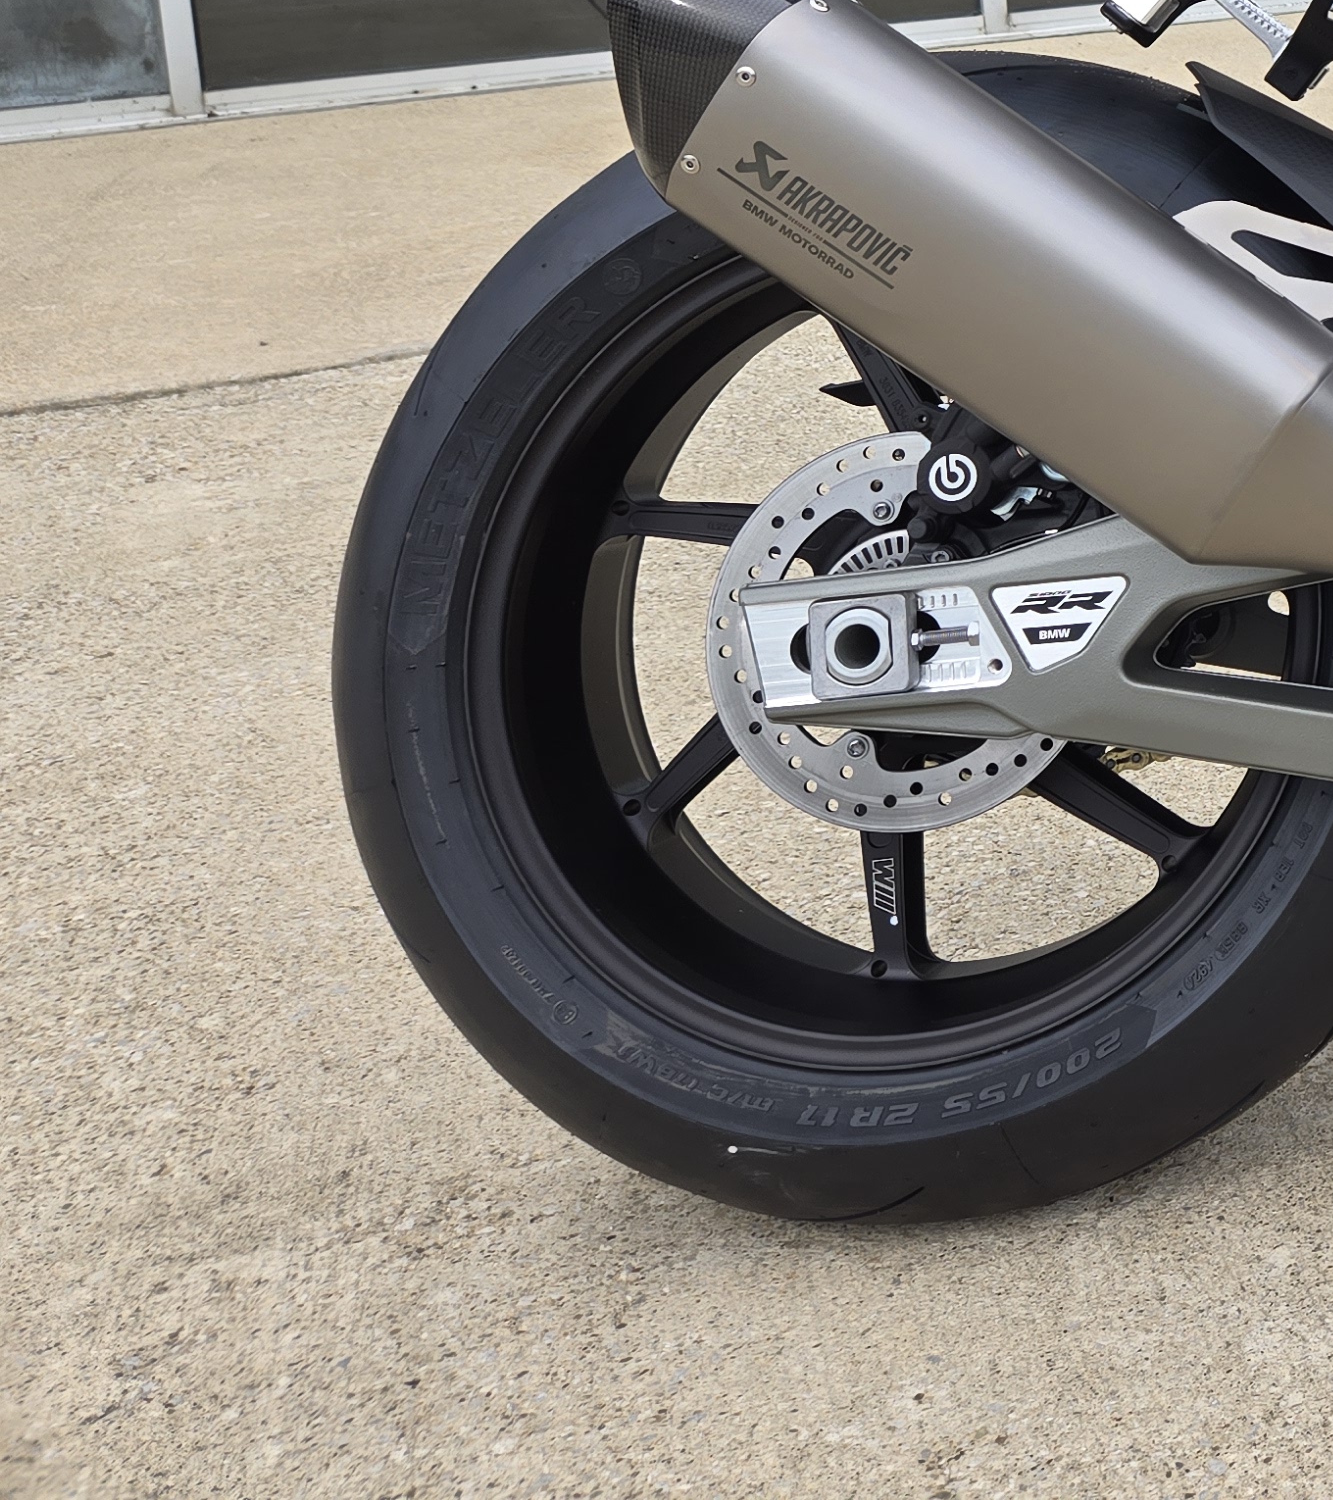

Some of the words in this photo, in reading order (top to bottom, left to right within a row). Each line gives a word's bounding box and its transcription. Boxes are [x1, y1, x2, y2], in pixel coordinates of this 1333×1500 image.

[742, 199, 779, 227] BMW
[778, 223, 854, 279] MOTORRAD
[402, 295, 602, 617] METZELER
[1010, 590, 1113, 614] RR
[1039, 628, 1071, 640] BMW
[940, 1027, 1124, 1120] 200/55
